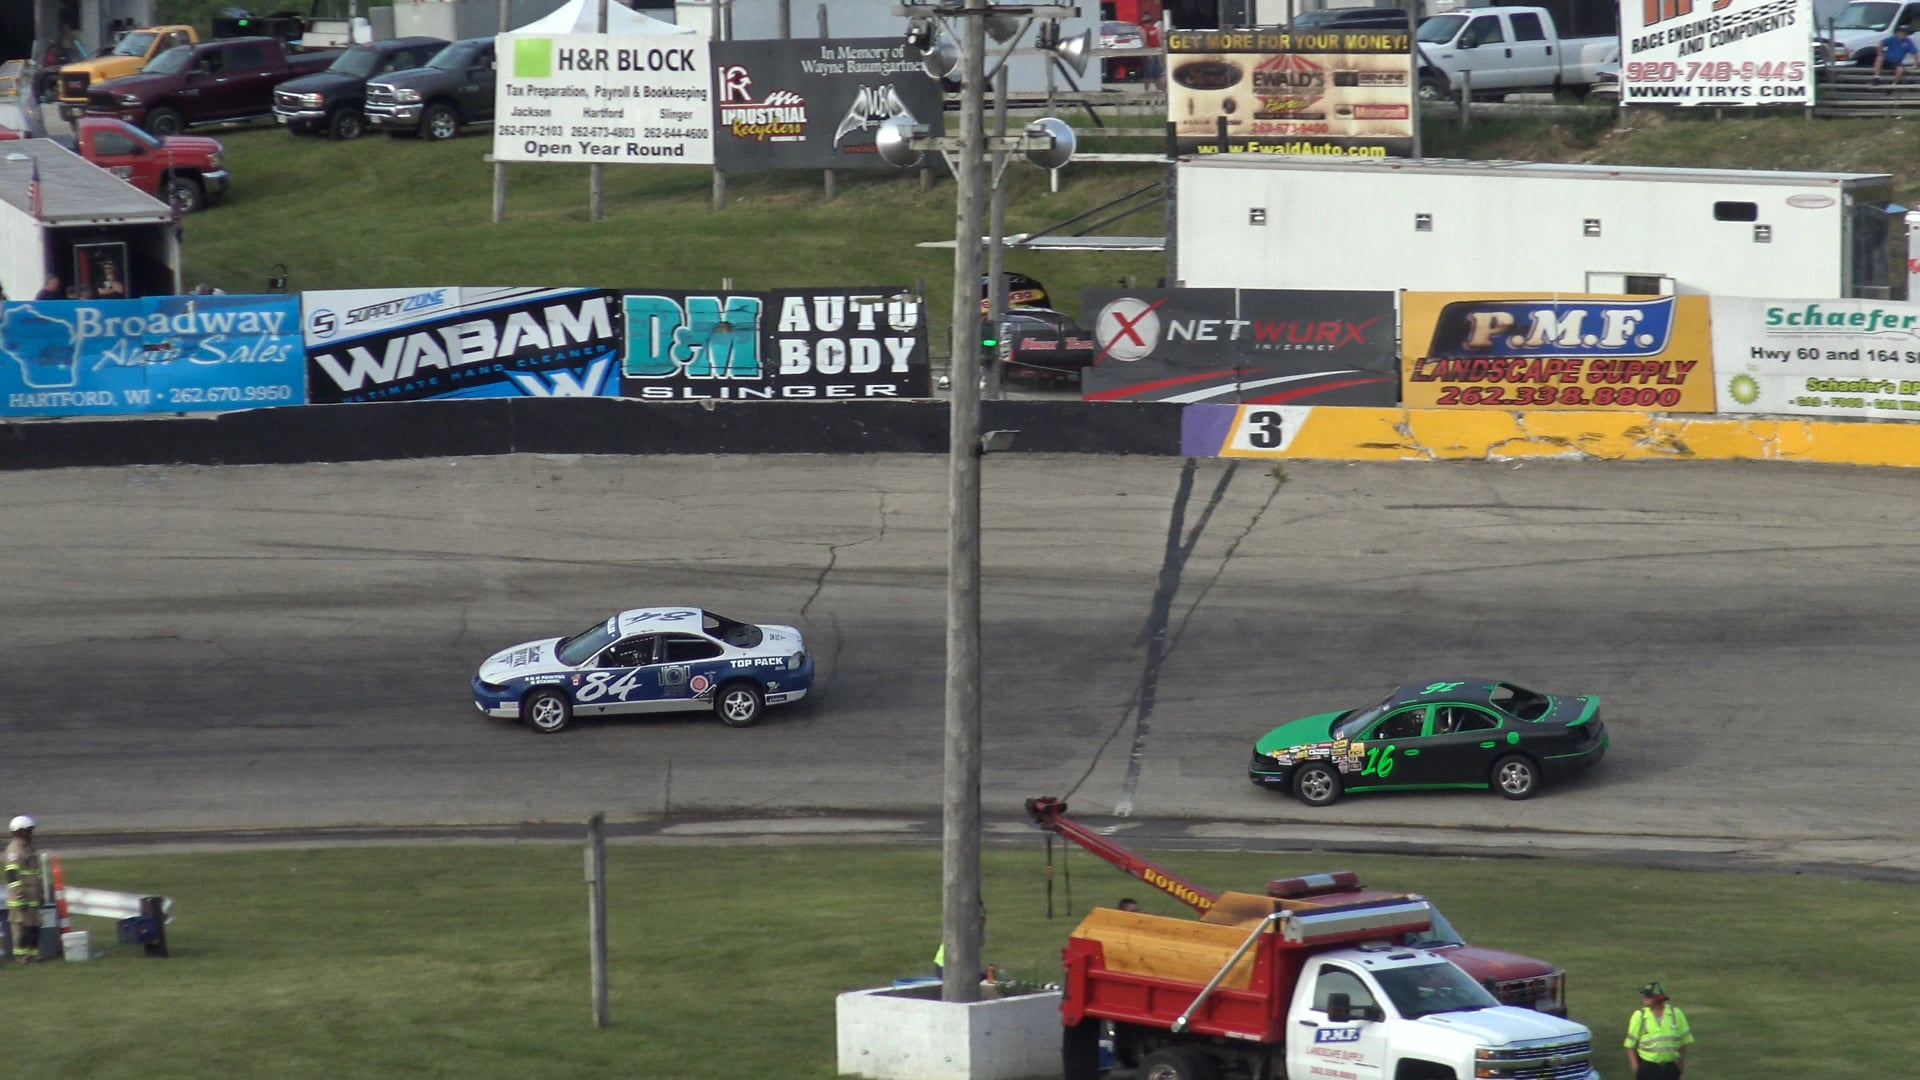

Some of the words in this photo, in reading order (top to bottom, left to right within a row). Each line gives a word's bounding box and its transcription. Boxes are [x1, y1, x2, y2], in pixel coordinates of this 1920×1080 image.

[1169, 34, 1201, 50] GET
[1207, 34, 1254, 50] MORE
[1257, 34, 1291, 50] FOR
[1297, 34, 1340, 50] YOUR
[1344, 34, 1409, 50] MONEY!
[1631, 31, 1665, 54] RACE
[1667, 15, 1720, 44] ENGINES
[1678, 37, 1704, 57] AND
[1709, 9, 1796, 48] COMPONENTS
[558, 48, 610, 72] H&R
[617, 48, 696, 72] BLOCK
[820, 45, 835, 60] In
[837, 46, 889, 62] Memory
[891, 43, 905, 58] of
[801, 59, 845, 77] Wayne
[1252, 71, 1326, 88] EWALD'S
[506, 84, 524, 97] Tax
[527, 85, 589, 100] Preparation,
[594, 86, 629, 101] Payroll
[632, 86, 640, 98] &
[643, 87, 708, 101] Bookkeeping
[511, 106, 552, 117] Jackson
[582, 107, 625, 119] Hartford
[659, 108, 694, 121] Slinger
[721, 106, 808, 126] INDUSTRIAL
[524, 140, 572, 157] Open
[578, 141, 621, 156] Year
[626, 142, 685, 157] Round
[74, 300, 287, 341] Broadway
[777, 294, 921, 332] AUTO
[622, 295, 763, 380] D&M
[1462, 309, 1655, 349] P.M.F.
[188, 334, 294, 366] Sales
[314, 296, 614, 392] WABAM
[779, 337, 917, 375] BODY
[1751, 346, 1791, 363] Hwy
[1797, 347, 1820, 361] 60
[1825, 348, 1860, 361] and
[1867, 350, 1900, 363] 164
[451, 364, 505, 380] HAND
[1409, 358, 1584, 384] LANDSCAPE
[1587, 359, 1698, 385] SUPPLY
[123, 389, 151, 405] WI
[170, 385, 291, 404] 262.670.9950
[641, 385, 899, 399] SLINGER
[1806, 376, 1896, 395] Schaefer's
[1436, 386, 1683, 407] 262.338.8800
[1248, 410, 1283, 450] 3
[729, 659, 752, 669] TOP
[754, 657, 784, 667] PACK
[575, 666, 643, 702] 84
[1361, 744, 1396, 778] 16
